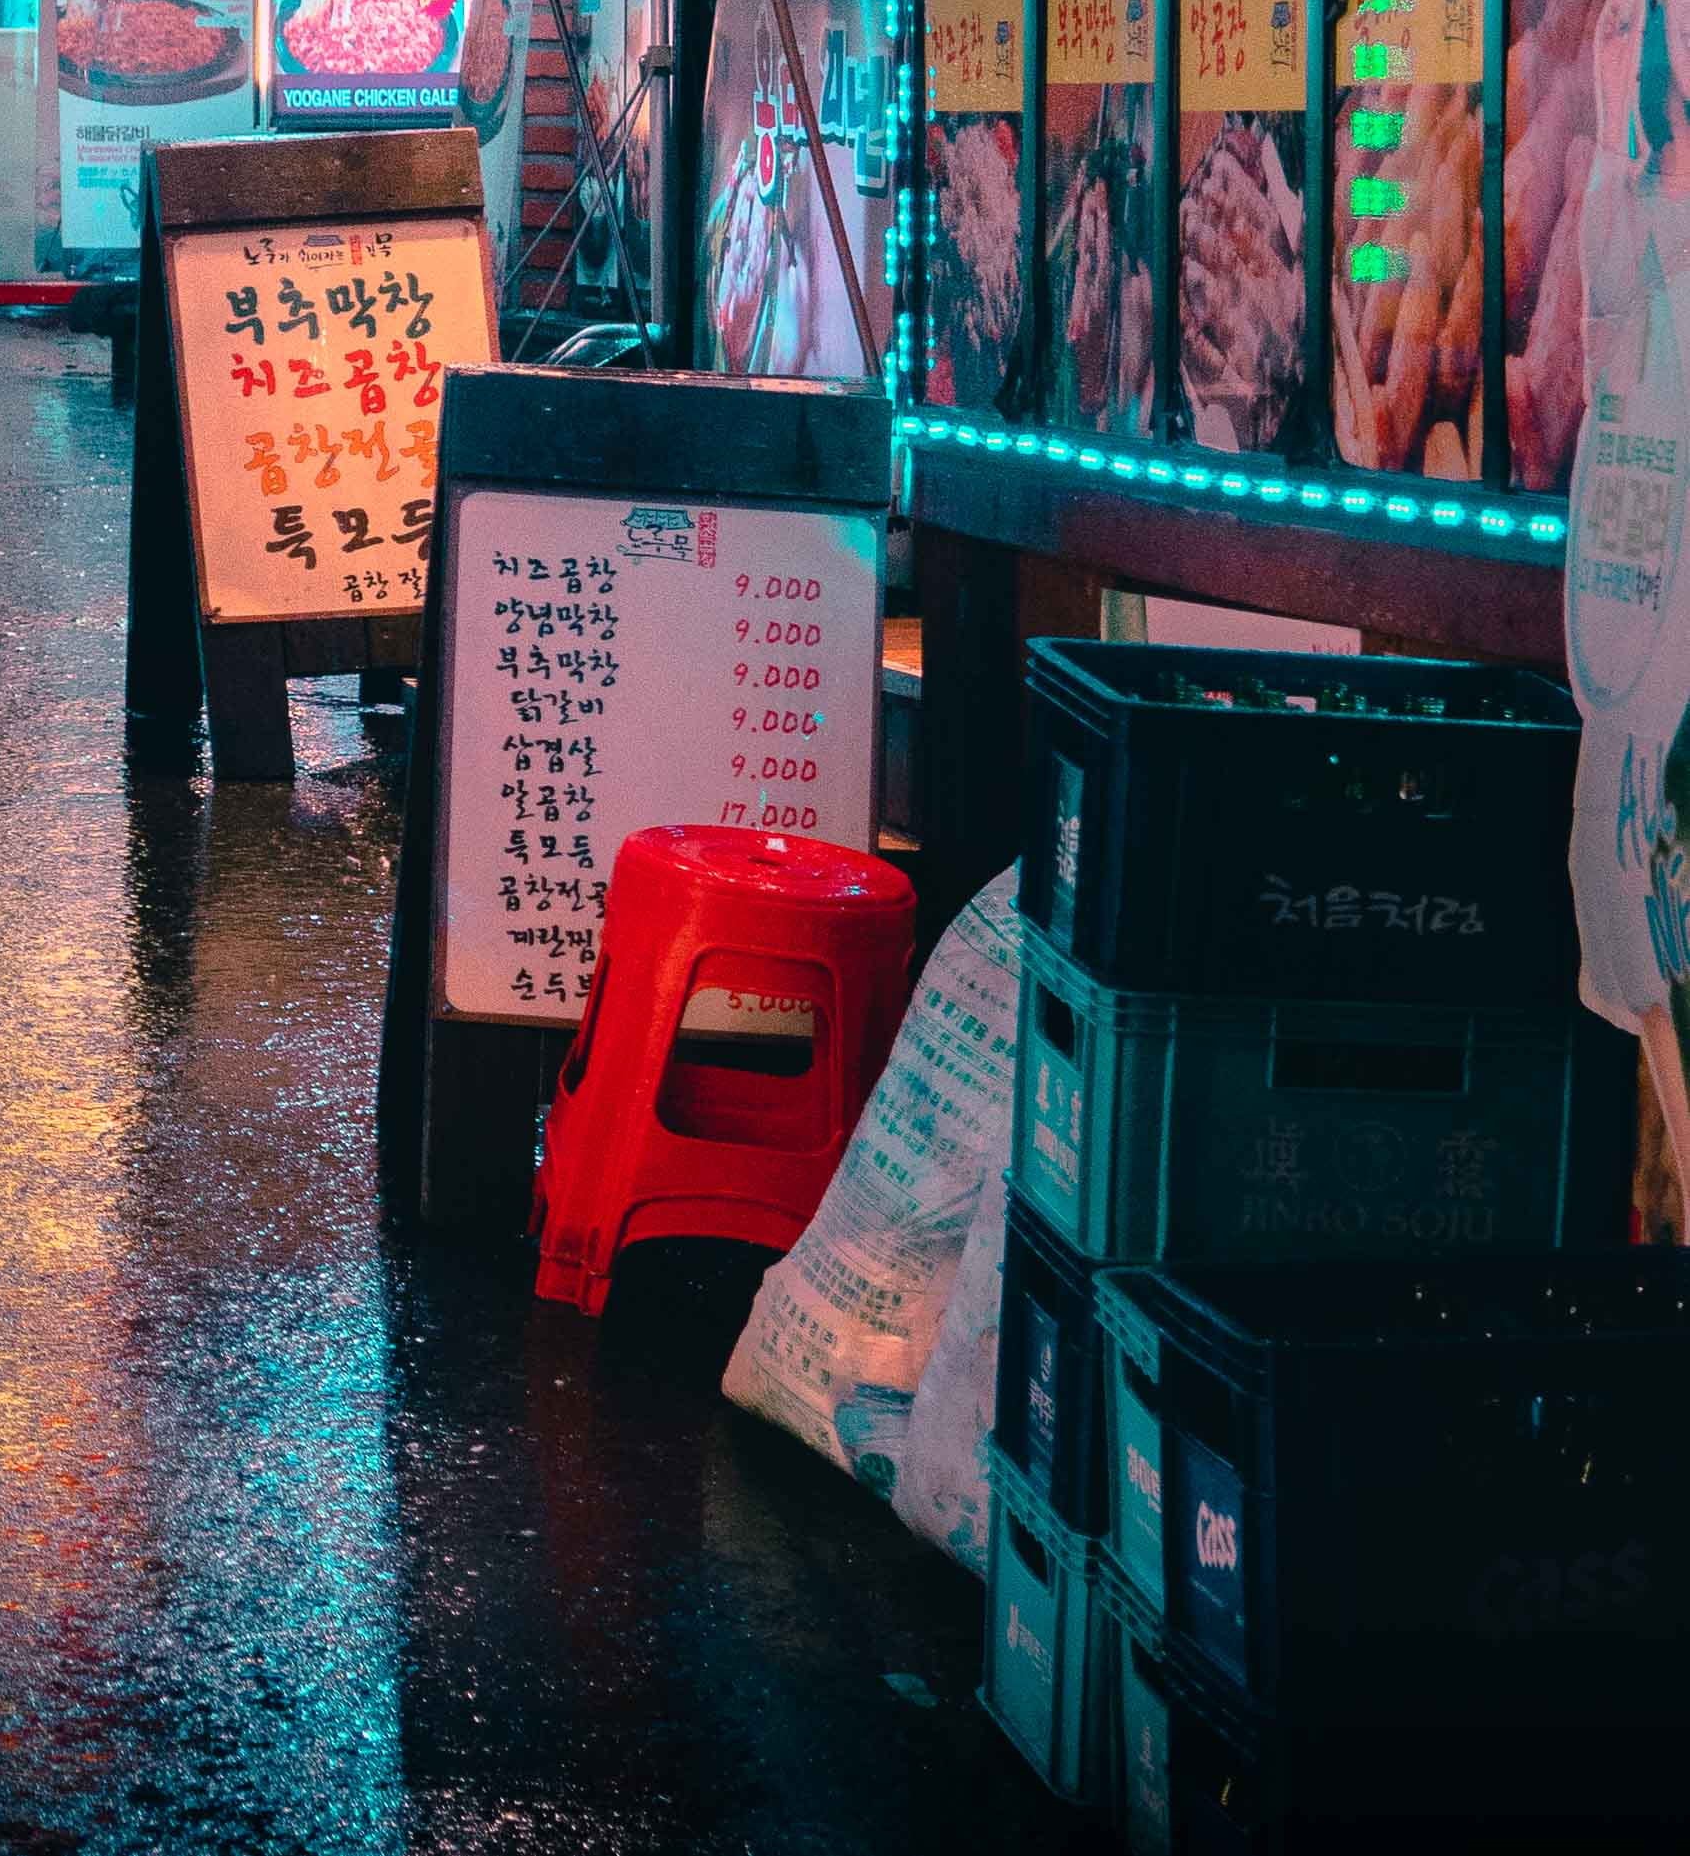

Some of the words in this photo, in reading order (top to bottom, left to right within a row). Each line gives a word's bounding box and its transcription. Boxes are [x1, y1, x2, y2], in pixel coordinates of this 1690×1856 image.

[284, 88, 351, 106] YOOGANE
[355, 88, 417, 107] CHICKEN
[224, 270, 435, 346] 부추막창
[230, 341, 442, 416] 치즈곱창
[492, 549, 619, 593] 치즈곱창
[733, 573, 822, 602] 9.000
[493, 597, 620, 640] 양념막창
[732, 616, 823, 647] 9.000
[494, 644, 621, 688] 부추막창
[732, 661, 822, 691] 9.000
[510, 688, 605, 722] 닭갈비
[731, 706, 822, 737] 9.000
[730, 753, 819, 783] 9.000
[501, 781, 597, 828] 알곱창
